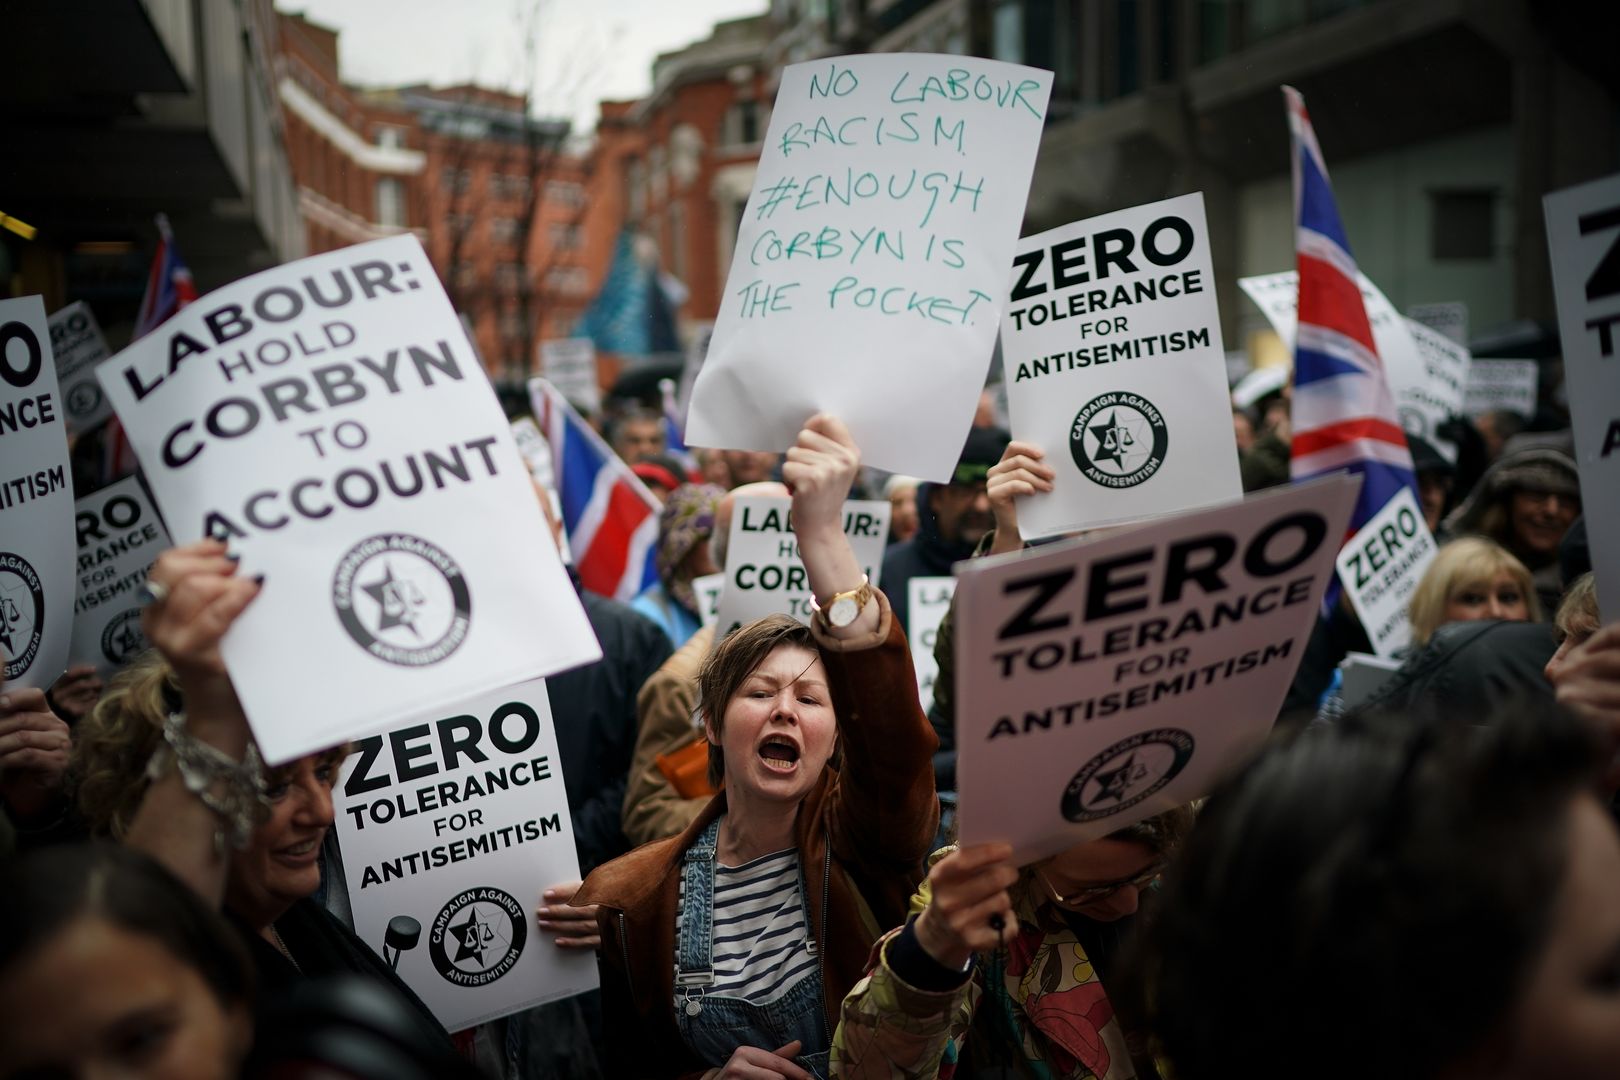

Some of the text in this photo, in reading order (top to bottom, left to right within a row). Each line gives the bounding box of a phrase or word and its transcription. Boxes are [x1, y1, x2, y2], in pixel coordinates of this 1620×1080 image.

[810, 64, 1042, 119] NO LABOUR
[751, 226, 965, 268] CORBYN IS
[1010, 216, 1194, 302] ZERO
[738, 280, 800, 318] THE
[1010, 270, 1203, 331] TOLERANCE
[123, 259, 423, 400] LABOUR:
[217, 321, 357, 383] HOLD
[1015, 327, 1210, 382] ANTISEMITISM
[1081, 316, 1129, 339] FOR
[161, 340, 464, 468] CORBYN
[1072, 394, 1163, 440] CAMPAIGN AGAINST
[298, 420, 369, 458] TO
[203, 437, 499, 541] ACCOUNT
[1085, 457, 1160, 486] ANTISEMITISM
[76, 495, 141, 548] RO
[1346, 506, 1417, 589] ZERO
[77, 523, 158, 577] RANCE
[81, 565, 116, 590] FOR
[996, 510, 1328, 641] ZERO
[993, 575, 1315, 679] TOLERANCE
[986, 638, 1294, 741] ANTISEMITISM
[1112, 647, 1191, 683] FOR
[344, 701, 540, 797] ZERO
[346, 756, 551, 830] TOLERANCE
[434, 809, 484, 836] FOR
[361, 813, 562, 889] ANTISEMITISM
[433, 889, 522, 944] CAMPAIGN AGAINST
[446, 948, 519, 984] ANTISEMITISM
